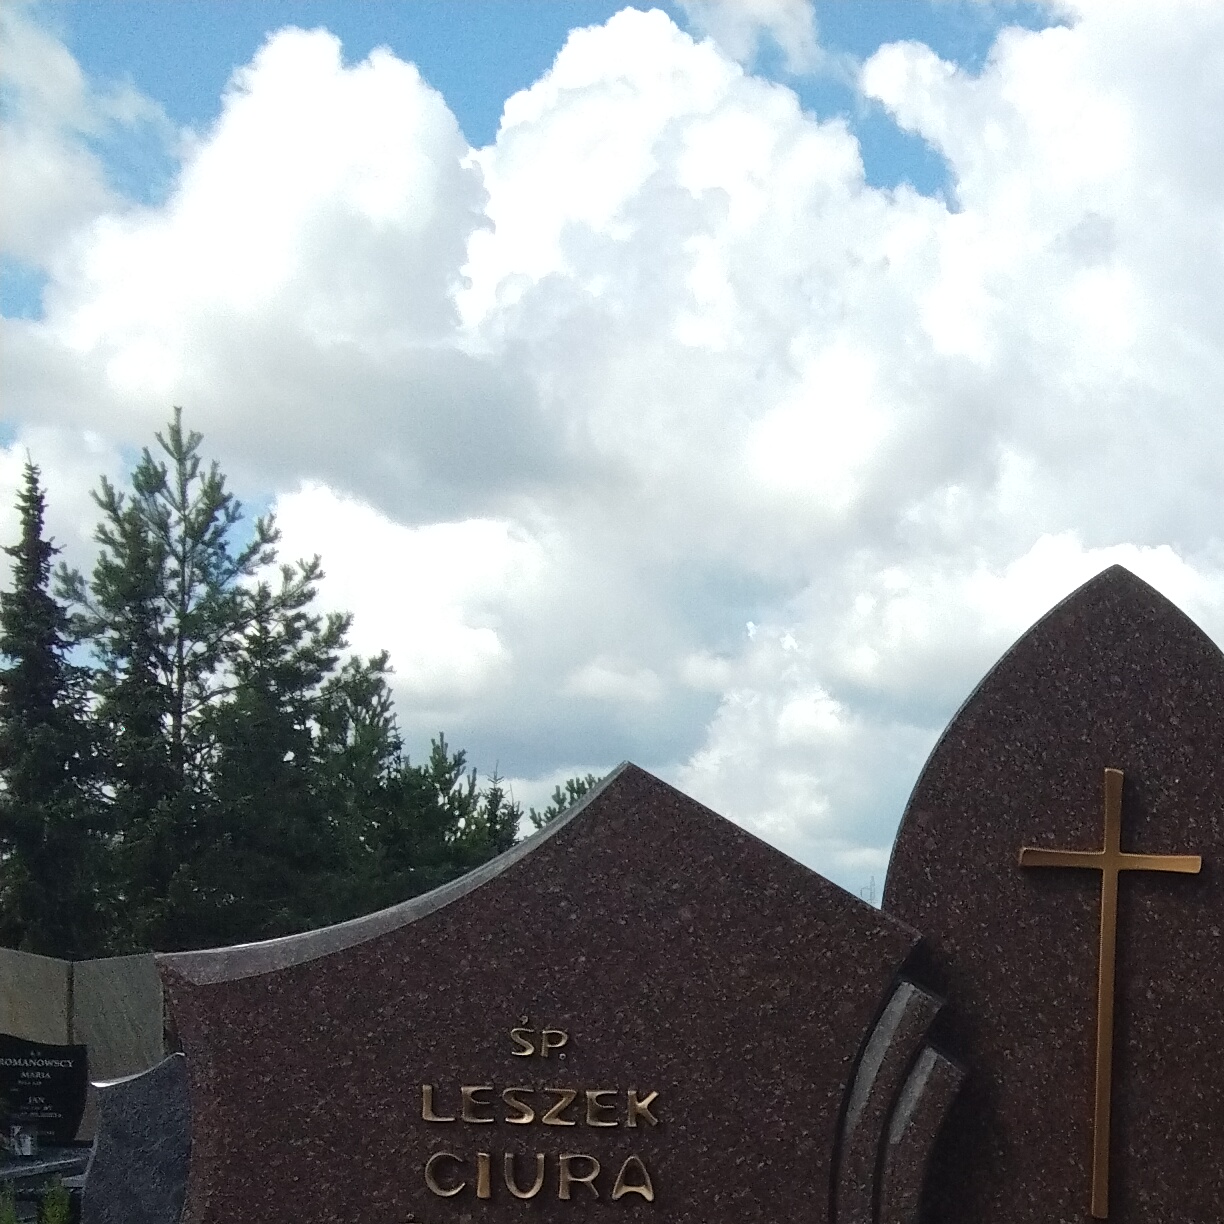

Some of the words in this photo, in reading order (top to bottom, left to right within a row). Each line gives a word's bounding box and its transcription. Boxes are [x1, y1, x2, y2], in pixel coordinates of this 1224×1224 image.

[21, 1071, 51, 1079] MARIA
[421, 1084, 659, 1128] LESZEK
[424, 1152, 655, 1201] CIURA
